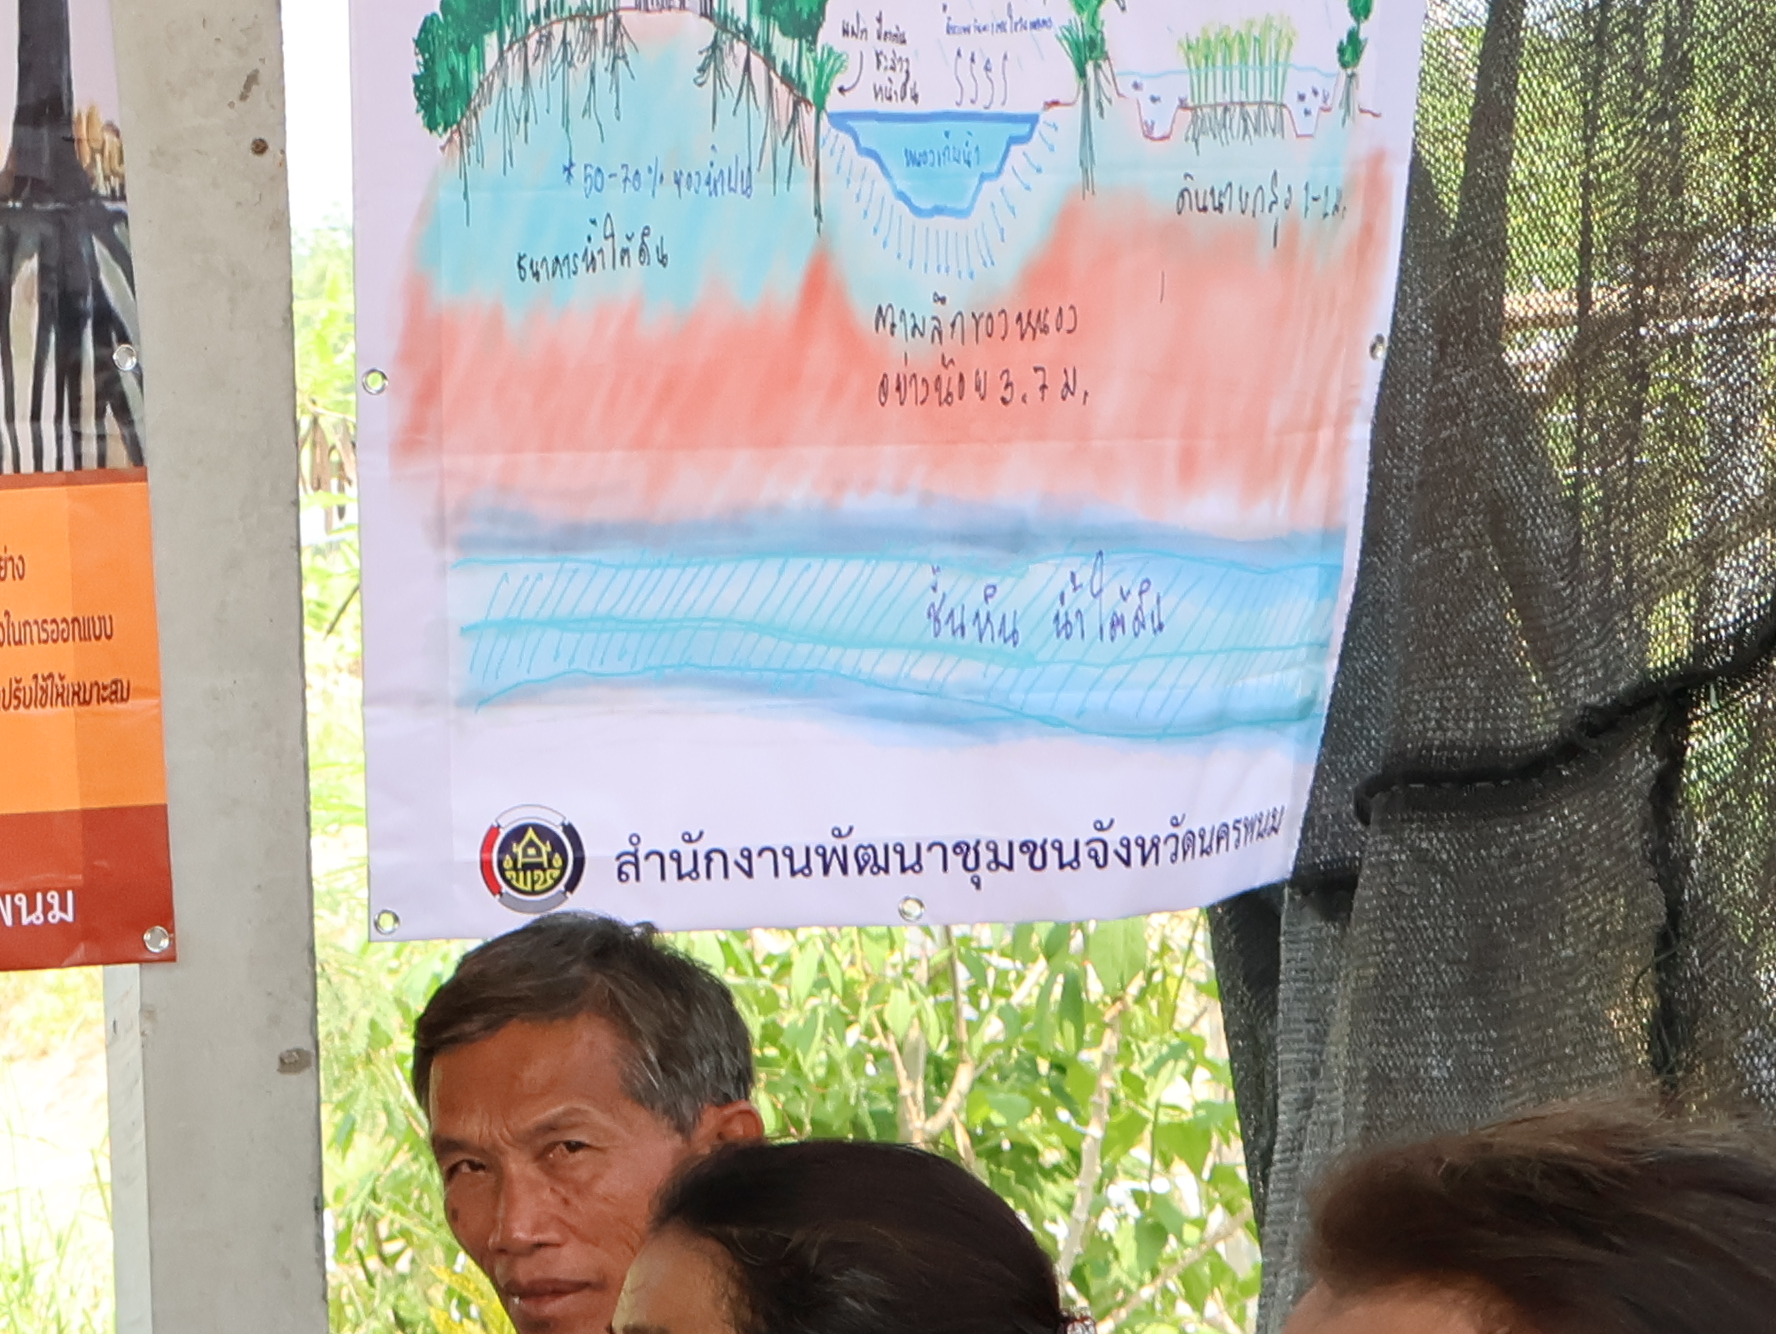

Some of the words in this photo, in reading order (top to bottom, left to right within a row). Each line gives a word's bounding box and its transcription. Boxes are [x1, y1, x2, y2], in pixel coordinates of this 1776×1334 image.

[614, 803, 1285, 891] สำนักงานพัฒนาชุมชนจังหวัดนครพนม
